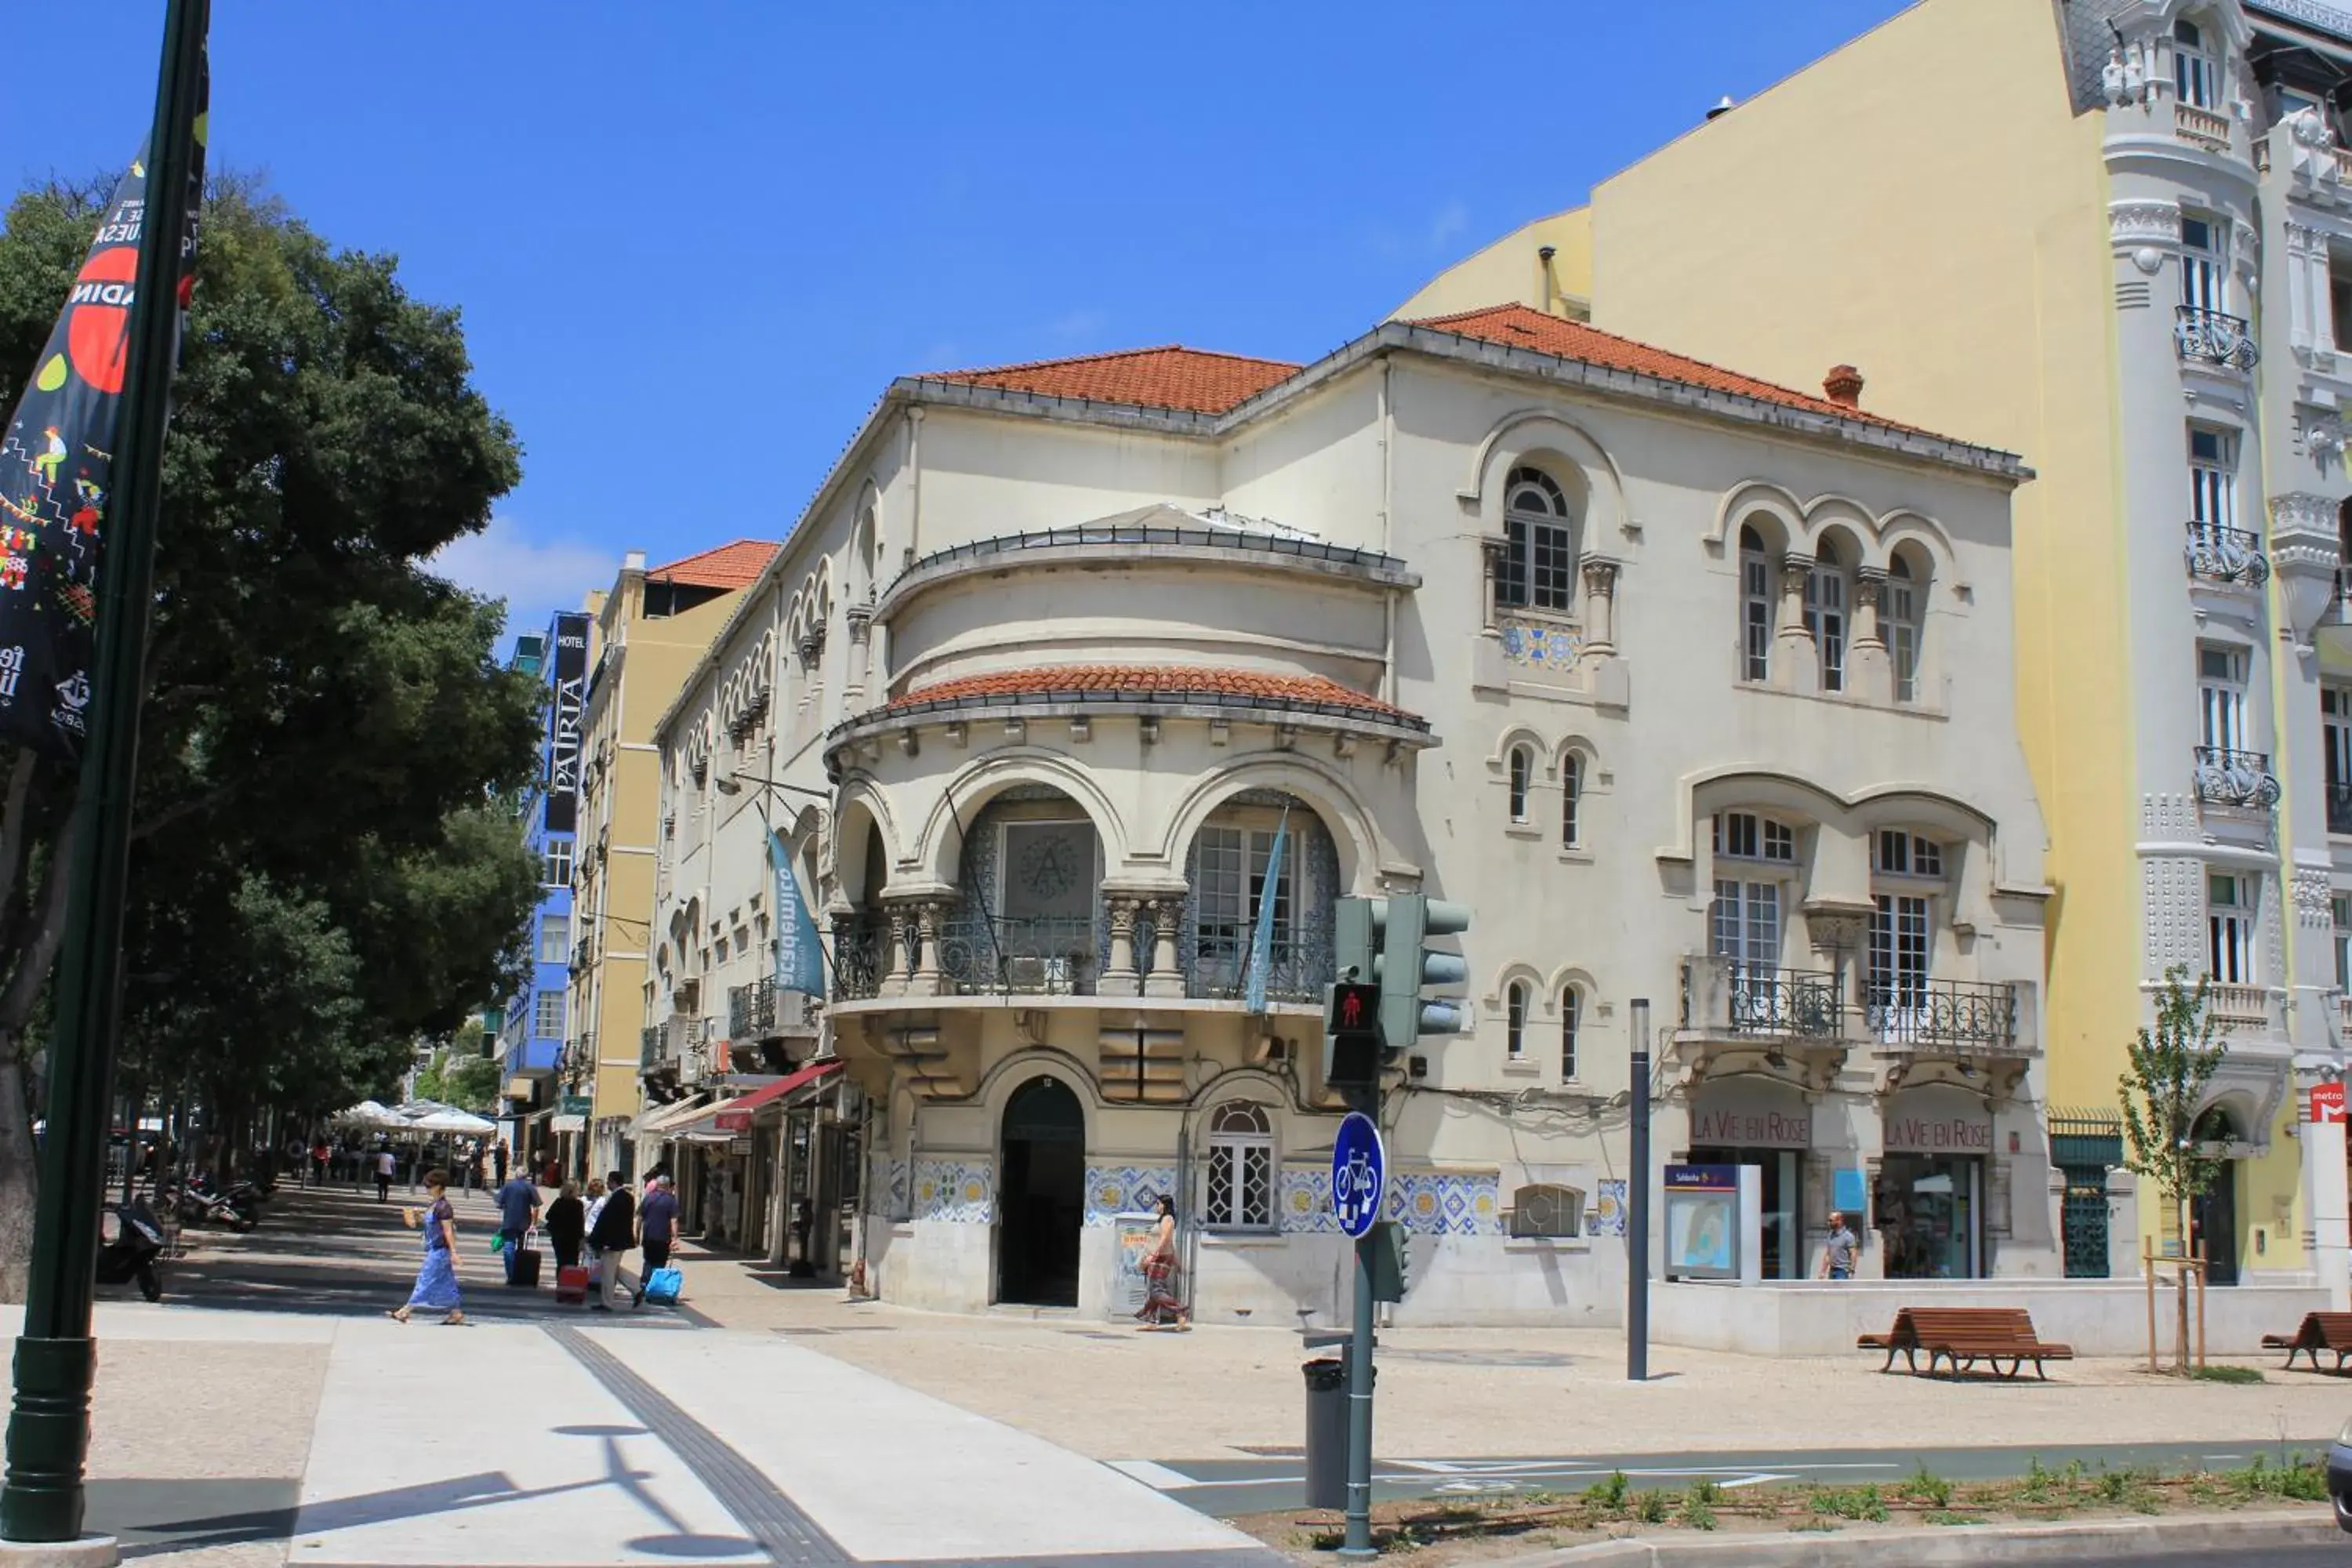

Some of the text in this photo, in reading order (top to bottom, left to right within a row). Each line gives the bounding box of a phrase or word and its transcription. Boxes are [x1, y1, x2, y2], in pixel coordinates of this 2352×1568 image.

[557, 636, 585, 648] HOTEL
[2313, 1091, 2343, 1101] metro
[1691, 1108, 1711, 1138] LA
[1715, 1108, 1740, 1140] VIE
[1769, 1111, 1807, 1142] ROSE
[1884, 1117, 1903, 1148] LA
[1906, 1117, 1929, 1147] VIE
[1954, 1118, 1990, 1148] ROSE
